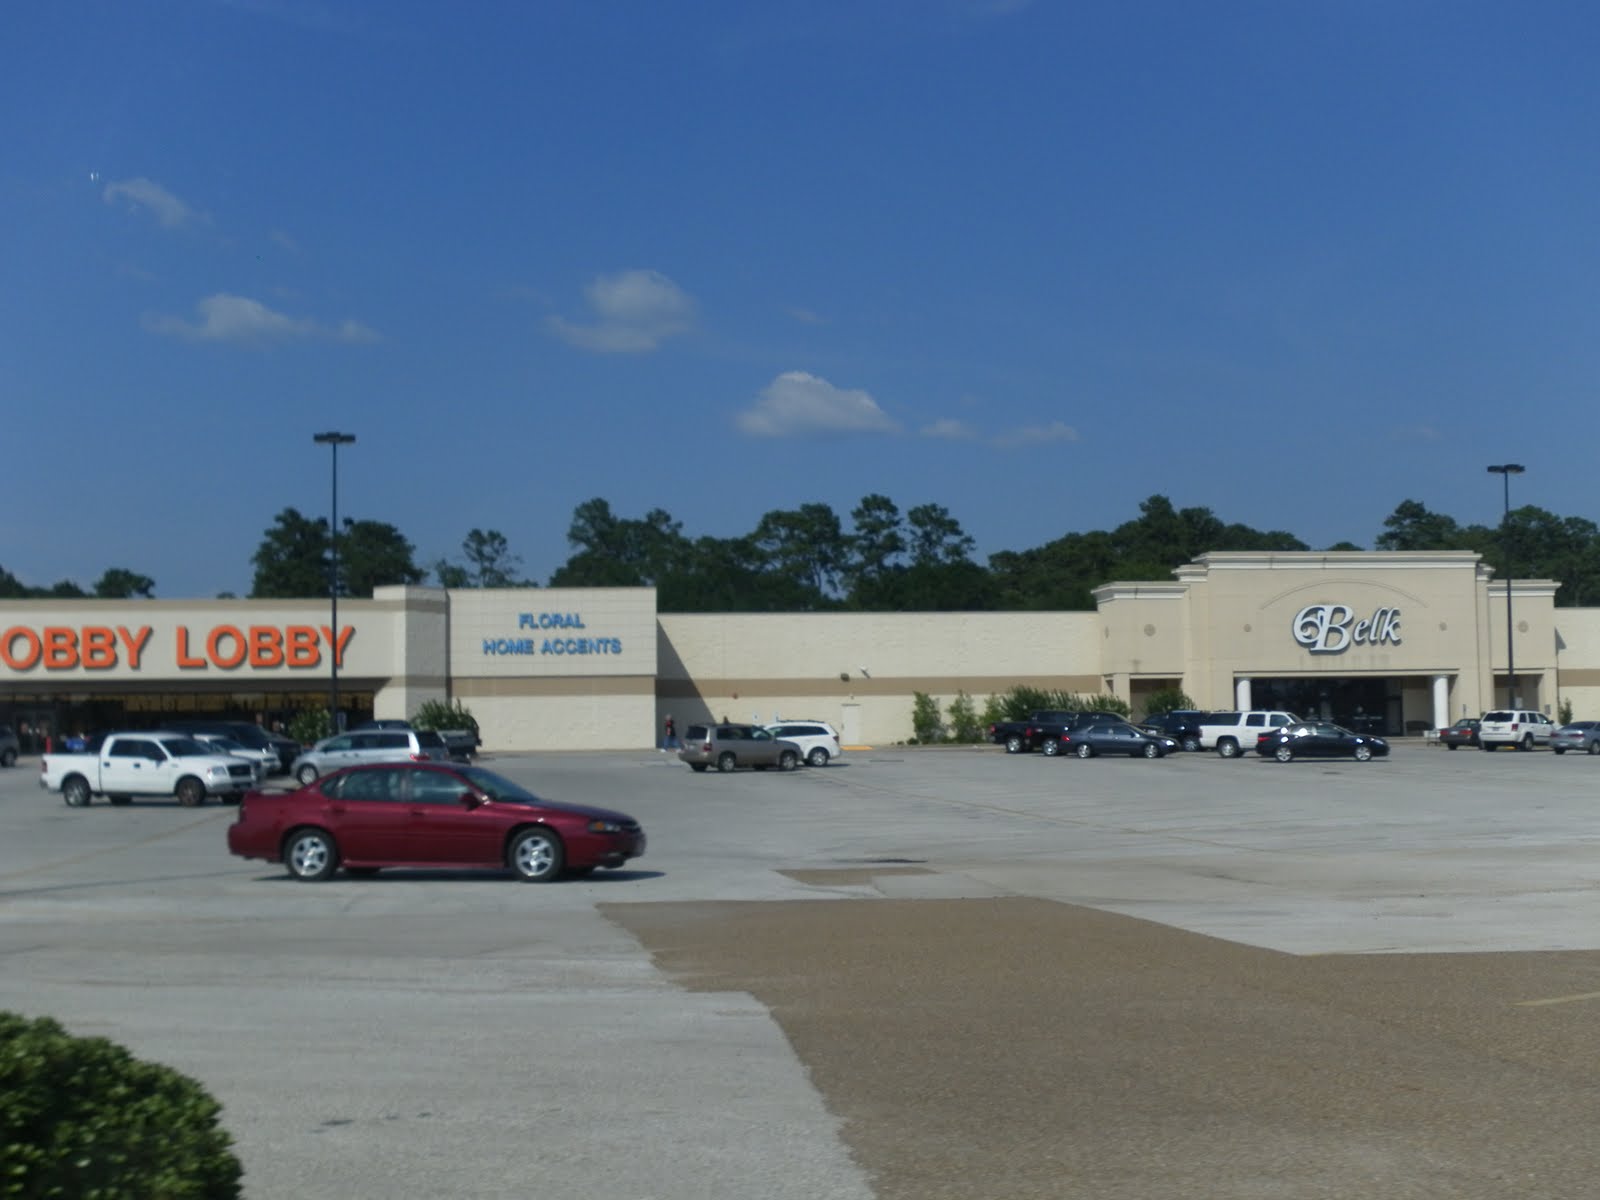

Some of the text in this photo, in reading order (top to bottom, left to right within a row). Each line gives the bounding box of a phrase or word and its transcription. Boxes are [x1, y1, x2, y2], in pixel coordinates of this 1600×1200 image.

[518, 612, 585, 630] FLORAL
[1293, 604, 1402, 655] Belk
[175, 624, 355, 669] LOBBY
[483, 637, 622, 656] HOME ACCENTS
